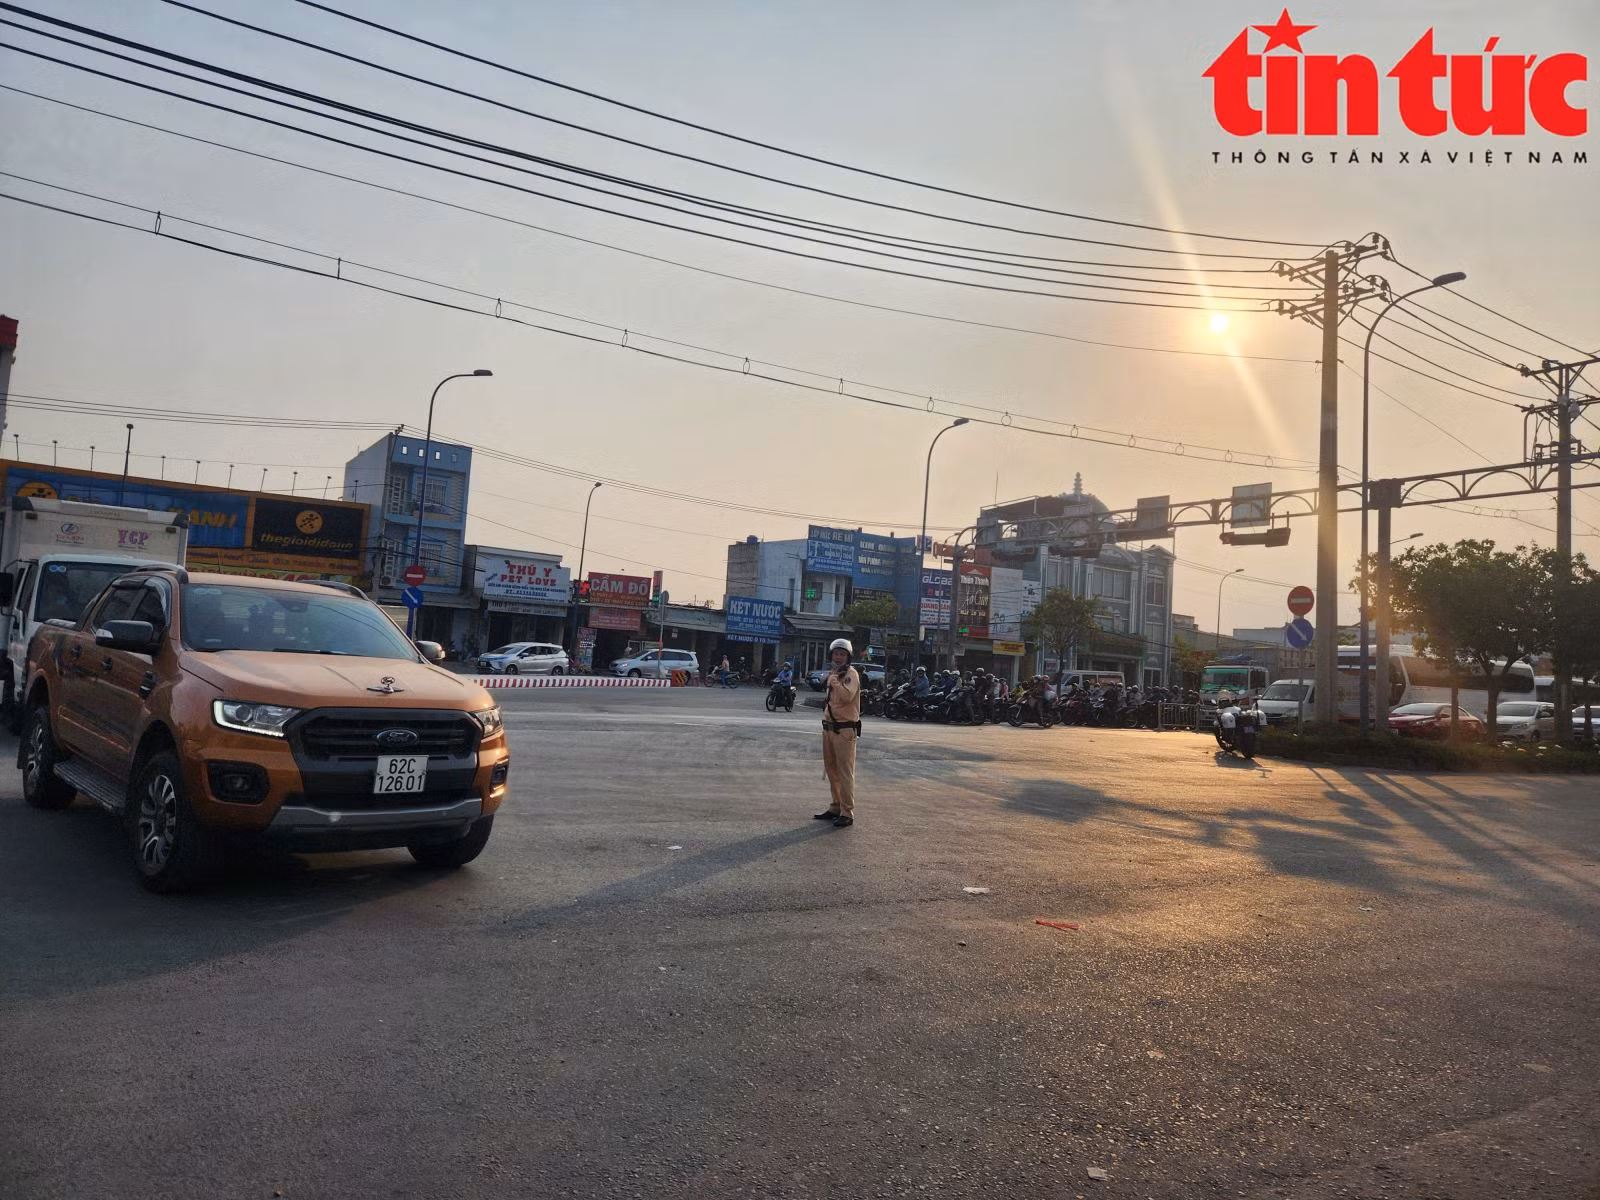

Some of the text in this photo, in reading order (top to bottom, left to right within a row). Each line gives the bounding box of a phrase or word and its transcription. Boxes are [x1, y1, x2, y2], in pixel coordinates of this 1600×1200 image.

[507, 563, 552, 578] THÚ Y
[500, 574, 523, 583] PET
[527, 576, 557, 586] LOVE
[389, 758, 417, 774] 62C
[378, 774, 423, 792] 126.01
